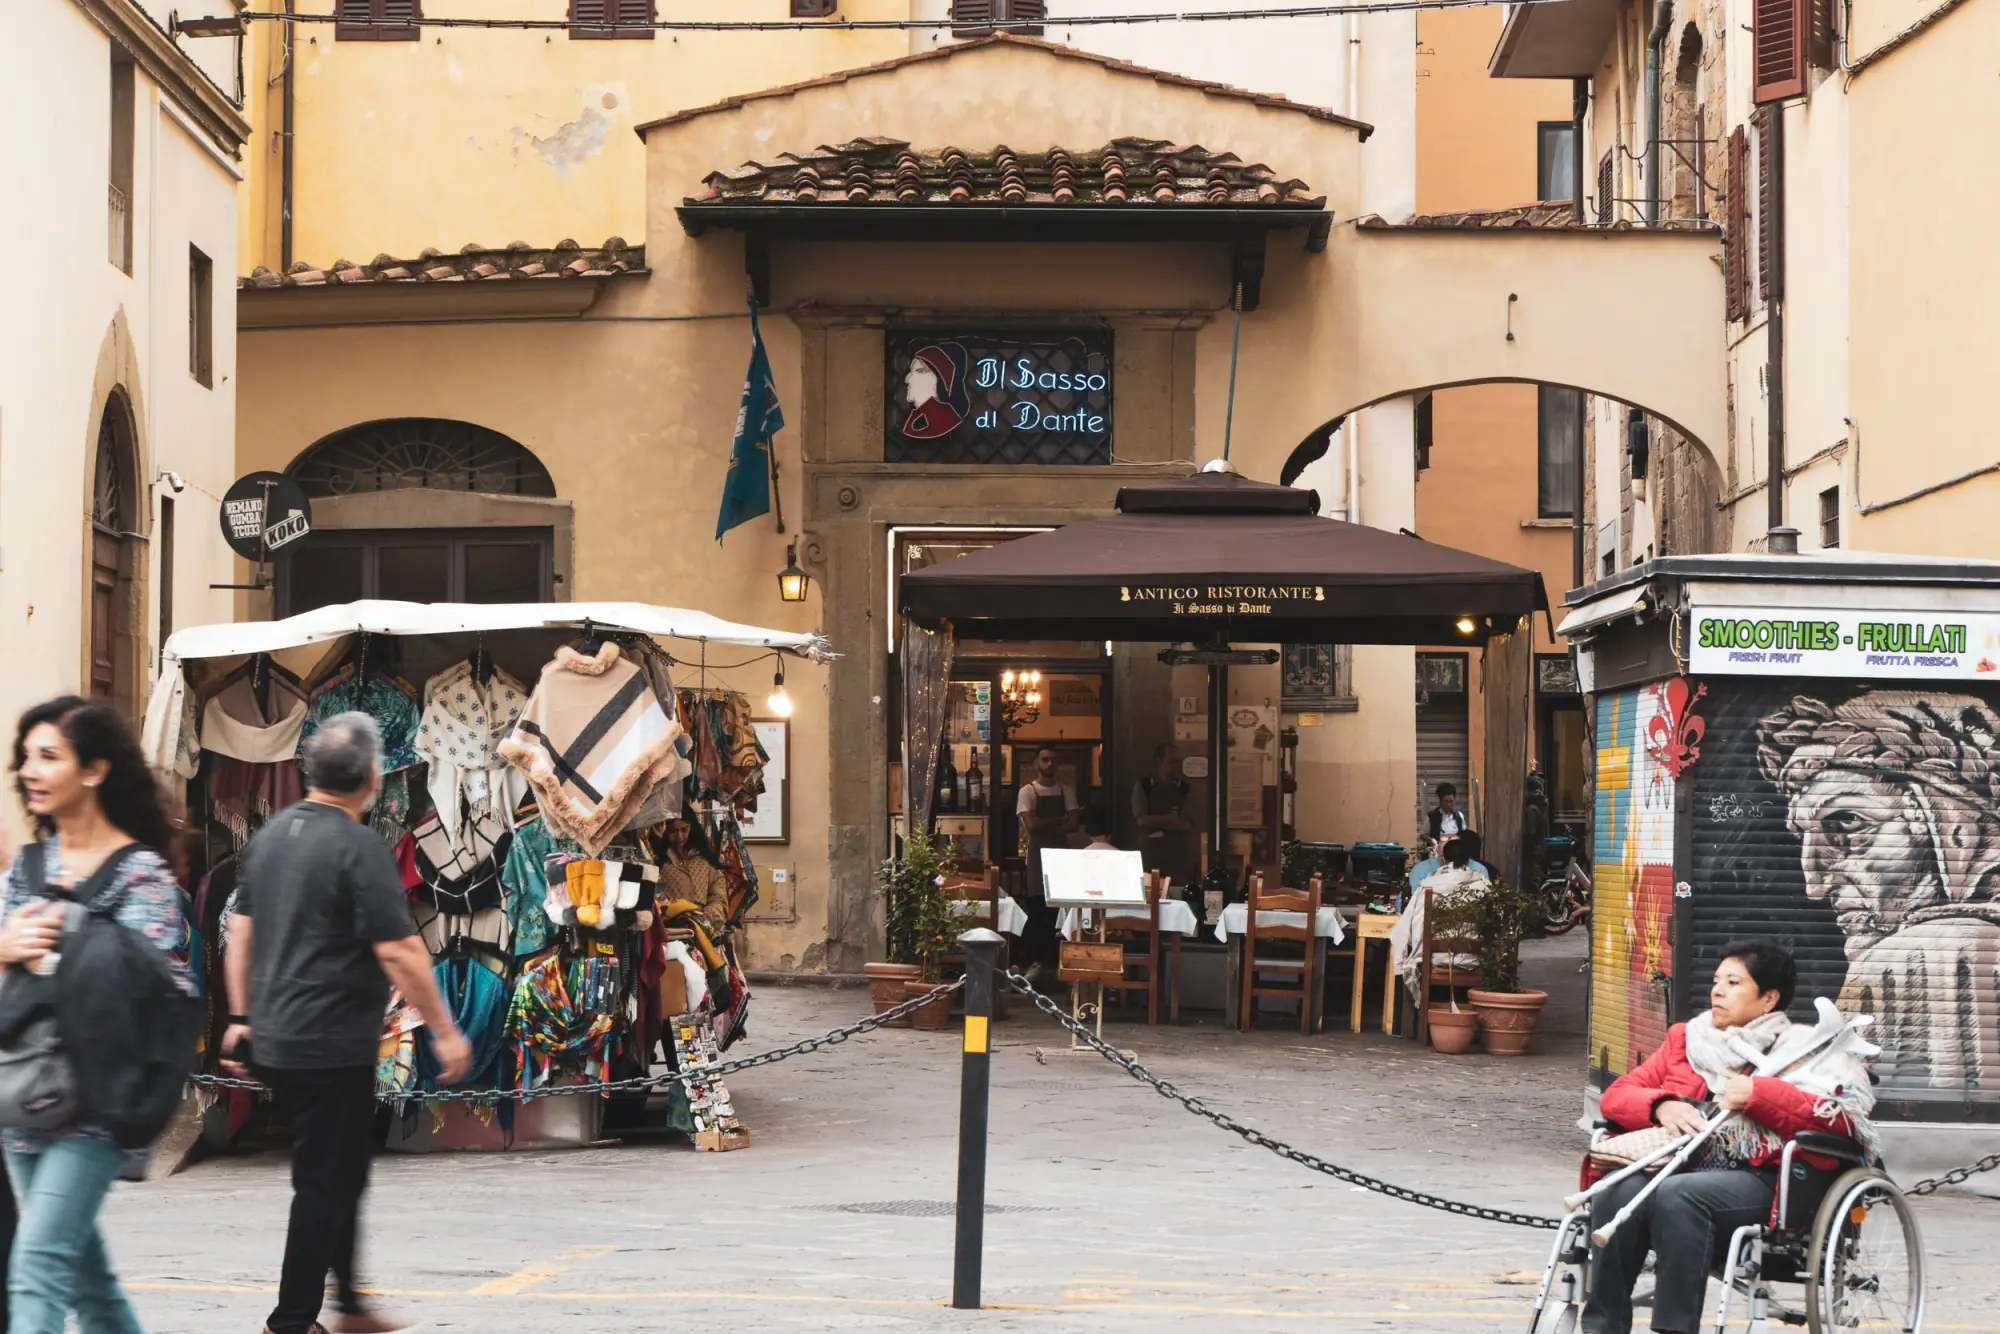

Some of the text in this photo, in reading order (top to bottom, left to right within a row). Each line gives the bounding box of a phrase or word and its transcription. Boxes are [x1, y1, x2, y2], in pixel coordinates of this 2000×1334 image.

[975, 358, 1106, 391] Il Sasso
[975, 401, 1105, 433] di Dante
[268, 516, 305, 546] KOKO
[1134, 586, 1312, 600] ANTICO RISTORANTE
[1172, 602, 1272, 614] Il Sasso di Dante
[1698, 618, 1839, 650] SMOOTHIES
[1858, 622, 1967, 654] FRULLATI
[1728, 651, 1803, 664] FRESH FRUIT
[1866, 655, 1959, 668] FRUTTA FRESCA
[1184, 698, 1193, 711] 6
